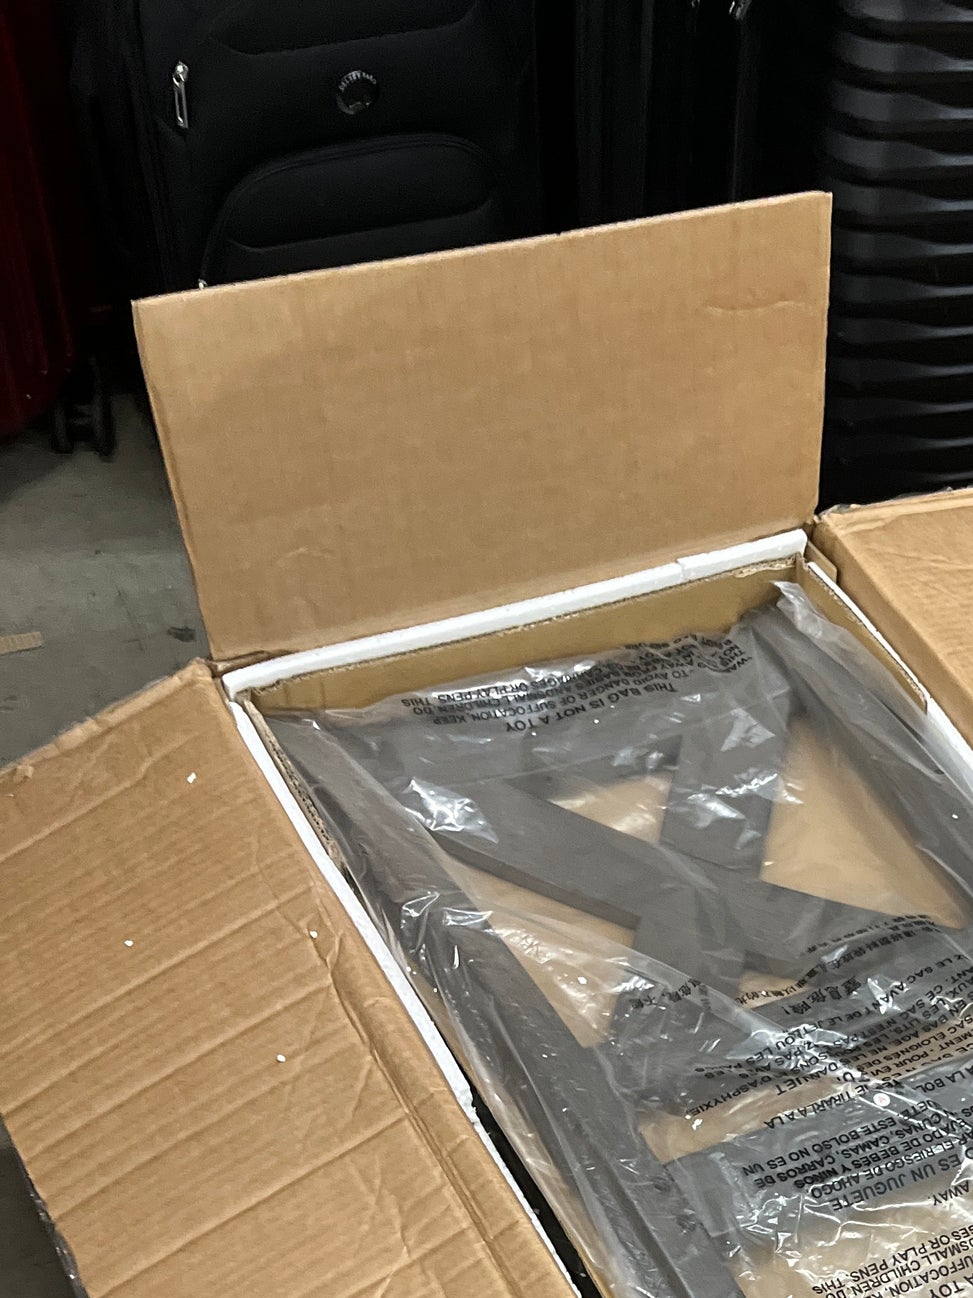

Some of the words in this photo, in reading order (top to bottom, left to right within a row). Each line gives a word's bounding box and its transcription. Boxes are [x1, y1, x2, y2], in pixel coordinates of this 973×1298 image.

[577, 676, 629, 700] DANGER
[607, 685, 640, 704] BAG
[644, 682, 676, 695] THIS
[559, 693, 576, 706] OF
[588, 697, 604, 710] IS
[433, 714, 465, 726] KEEP
[538, 714, 550, 725] A
[554, 703, 585, 721] NOT
[505, 718, 534, 732] TOY
[934, 956, 952, 971] LE
[905, 965, 934, 986] SAC
[858, 979, 905, 1016] AVANT
[923, 983, 944, 1001] CE
[845, 1009, 861, 1021] DE
[898, 997, 925, 1021] SAC
[919, 997, 946, 1020] LES
[947, 999, 967, 1017] EN
[824, 1015, 843, 1027] LE
[922, 1013, 947, 1033] BAS
[945, 1013, 973, 1036] SAC
[865, 1031, 889, 1048] LES
[744, 1046, 773, 1066] LES
[867, 1042, 886, 1056] NE
[893, 1048, 928, 1069] POUR
[945, 1069, 965, 1085] LA
[797, 1090, 851, 1118] TIRARLA
[763, 1115, 784, 1131] LA
[784, 1111, 796, 1124] A
[861, 1115, 896, 1136] ESTE
[810, 1127, 862, 1154] BOLSO
[835, 1133, 890, 1162] CAMAS,
[900, 1136, 920, 1151] DE
[935, 1139, 954, 1153] EL
[765, 1155, 785, 1170] ES
[787, 1146, 809, 1162] NO
[849, 1145, 899, 1171] BEBÉS
[884, 1146, 935, 1172] RIESGO
[936, 1152, 960, 1171] ES
[741, 1161, 763, 1176] UN
[776, 1154, 835, 1183] CARROS
[839, 1161, 852, 1174] Y
[862, 1165, 883, 1180] DE
[909, 1162, 934, 1181] UN
[753, 1174, 774, 1189] DE
[810, 1173, 861, 1199] AHOGO
[829, 1174, 908, 1211] JUGUETE
[928, 1181, 969, 1207] AWAY.
[928, 1233, 949, 1249] OR
[889, 1242, 927, 1266] PLAY
[811, 1277, 843, 1296] THIS
